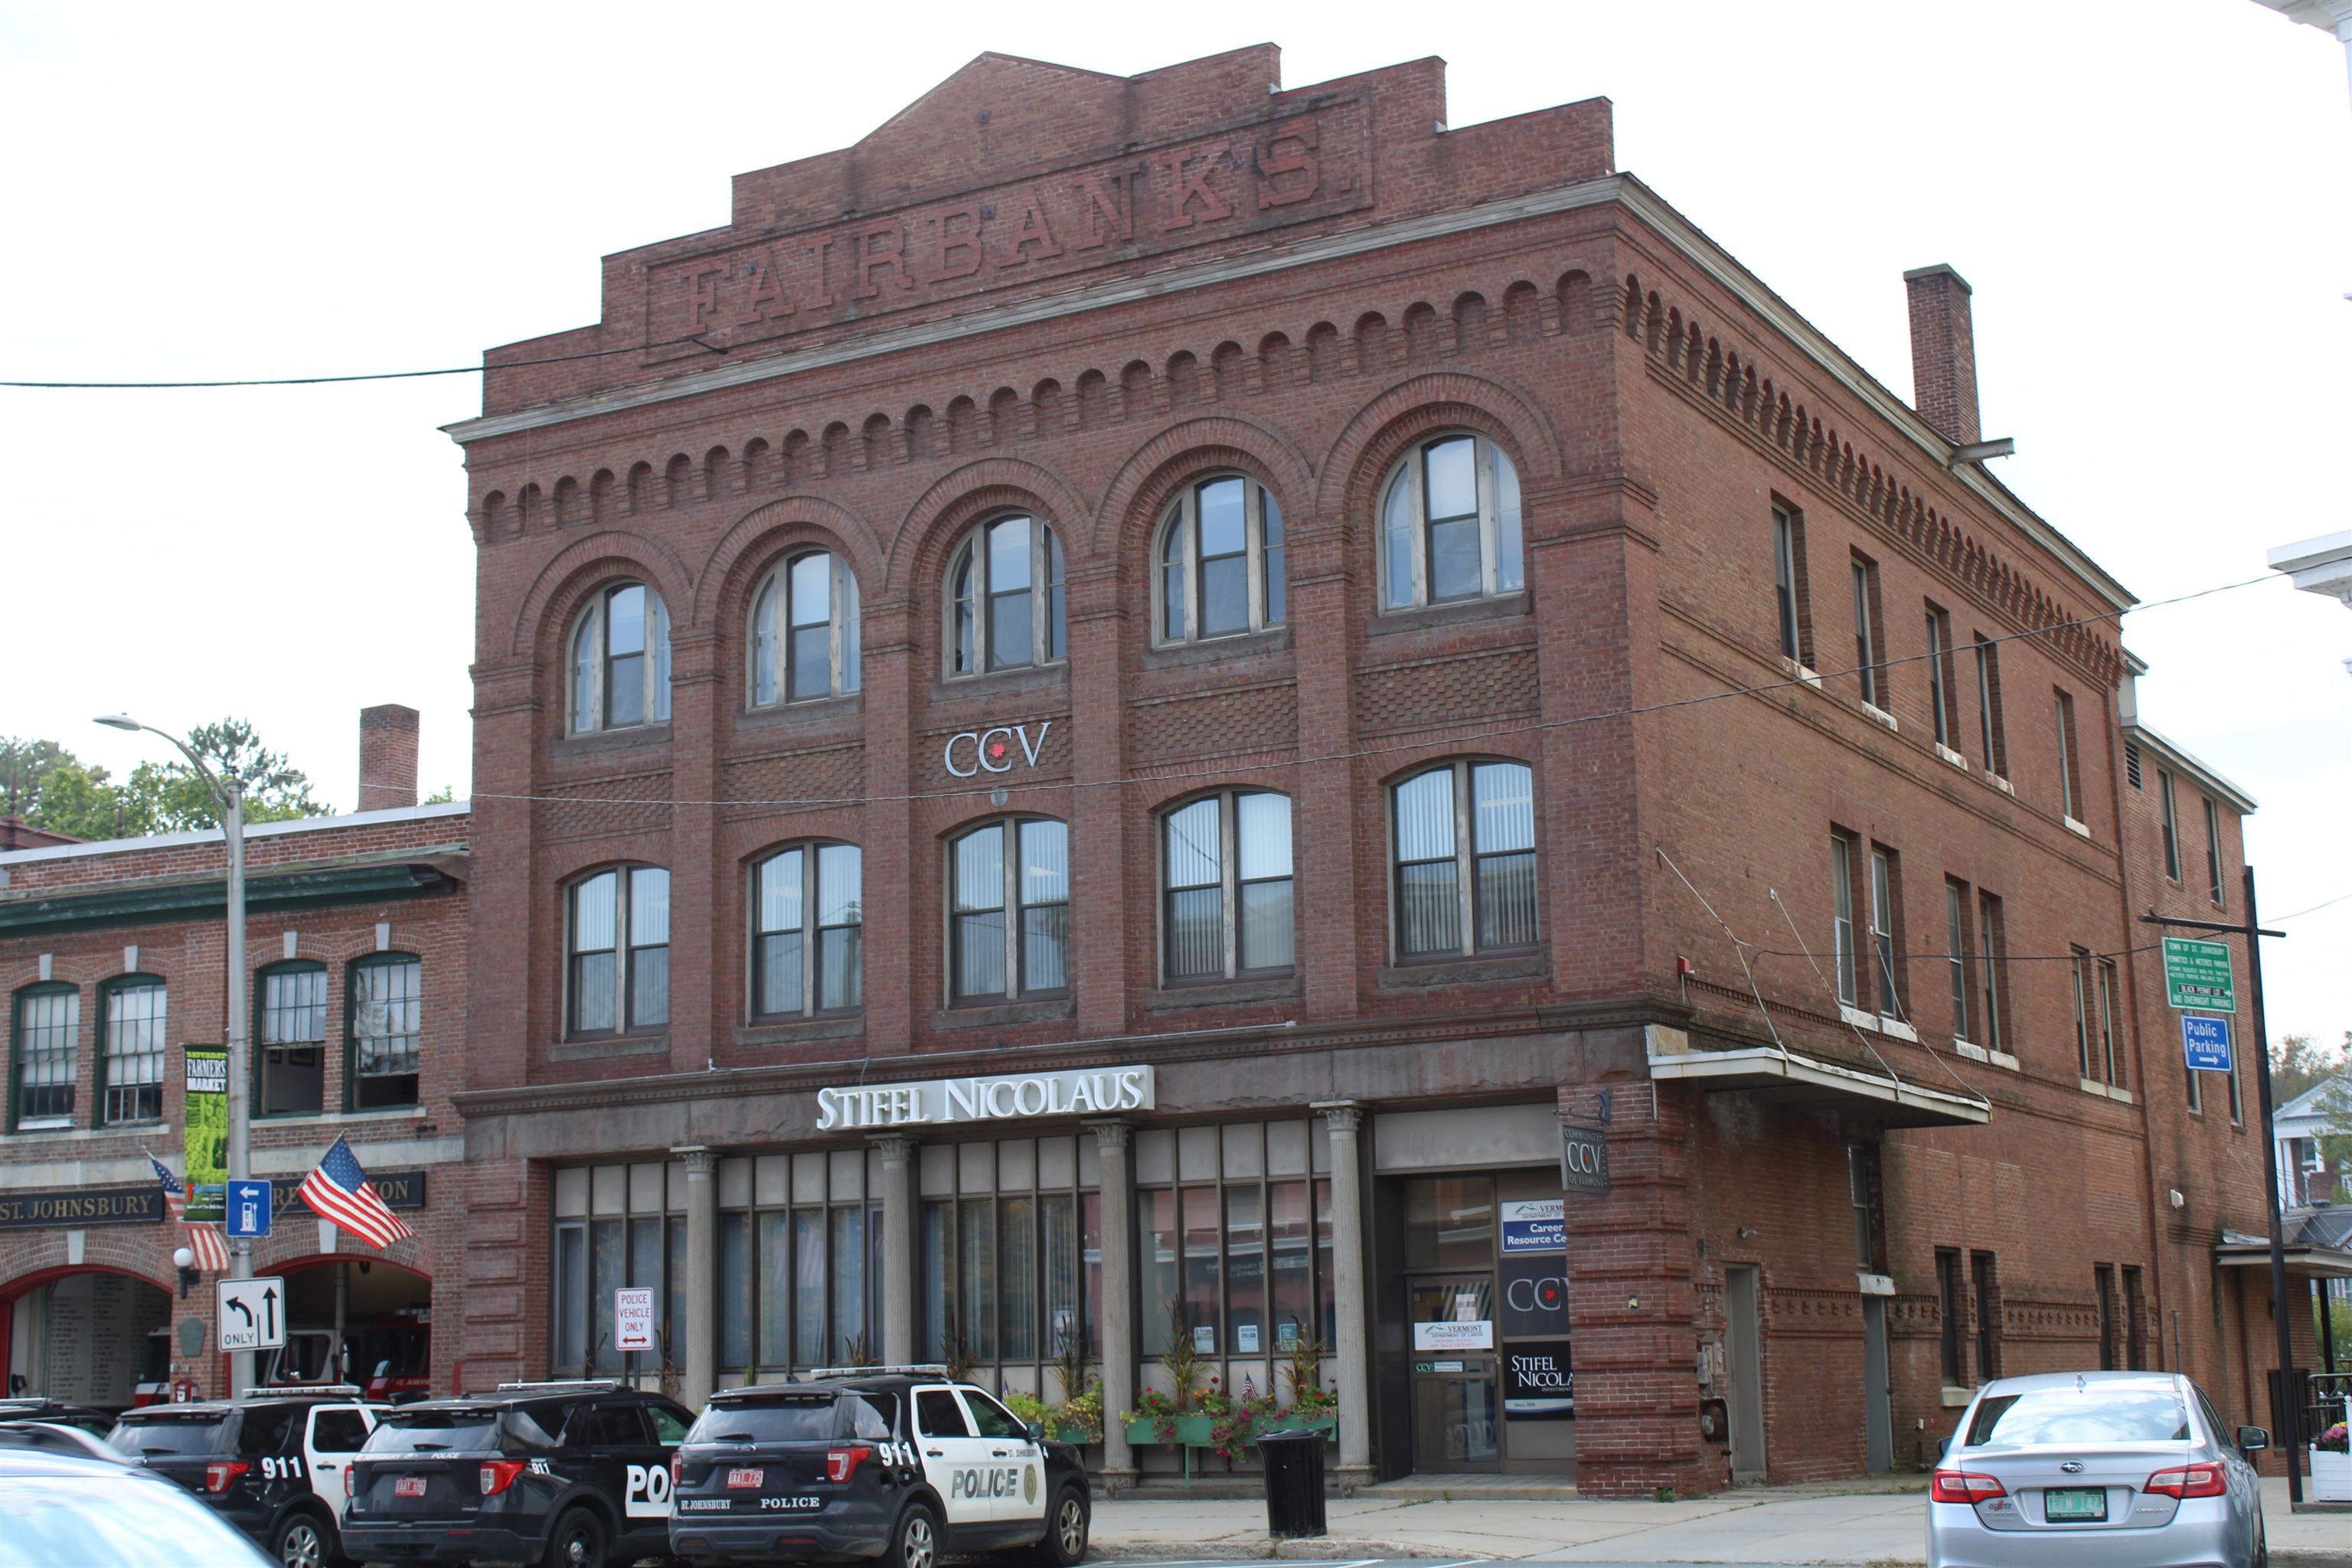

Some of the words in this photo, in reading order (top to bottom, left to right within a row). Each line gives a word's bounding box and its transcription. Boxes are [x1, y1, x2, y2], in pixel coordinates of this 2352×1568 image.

[945, 722, 1052, 777] CCV
[2180, 985, 2195, 993] BLACK
[2187, 1021, 2217, 1037] Public
[2189, 1037, 2226, 1057] Parking
[187, 1059, 227, 1077] FARMERS
[187, 1078, 227, 1091] MARKET
[817, 1086, 932, 1131] STIFEL
[942, 1072, 1145, 1122] NICOLAUS
[1567, 1142, 1601, 1174] CCV
[273, 1186, 299, 1206] RE
[373, 1180, 409, 1200] ON
[0, 1202, 24, 1220] ST.
[28, 1195, 153, 1220] JOHNSBURY
[1530, 1223, 1564, 1233] Career
[1507, 1235, 1551, 1245] Resource
[1553, 1233, 1567, 1243] Ce
[621, 1294, 648, 1304] POLICE
[1508, 1277, 1570, 1312] CC
[619, 1308, 650, 1318] VEHICLE
[625, 1322, 645, 1331] ONLY
[224, 1333, 254, 1345] ONLY
[1416, 1363, 1433, 1372] CCV
[1511, 1355, 1557, 1372] STIFEL
[1518, 1371, 1574, 1387] NICOLA
[879, 1442, 915, 1467] 911
[1016, 1449, 1037, 1458] JOHNSBURY
[262, 1456, 302, 1479] 911
[531, 1462, 550, 1475] 911
[951, 1468, 1018, 1499] POLICE
[681, 1501, 689, 1510] ST.
[690, 1499, 730, 1510] JOHNSBURY
[760, 1497, 820, 1509] POLICE
